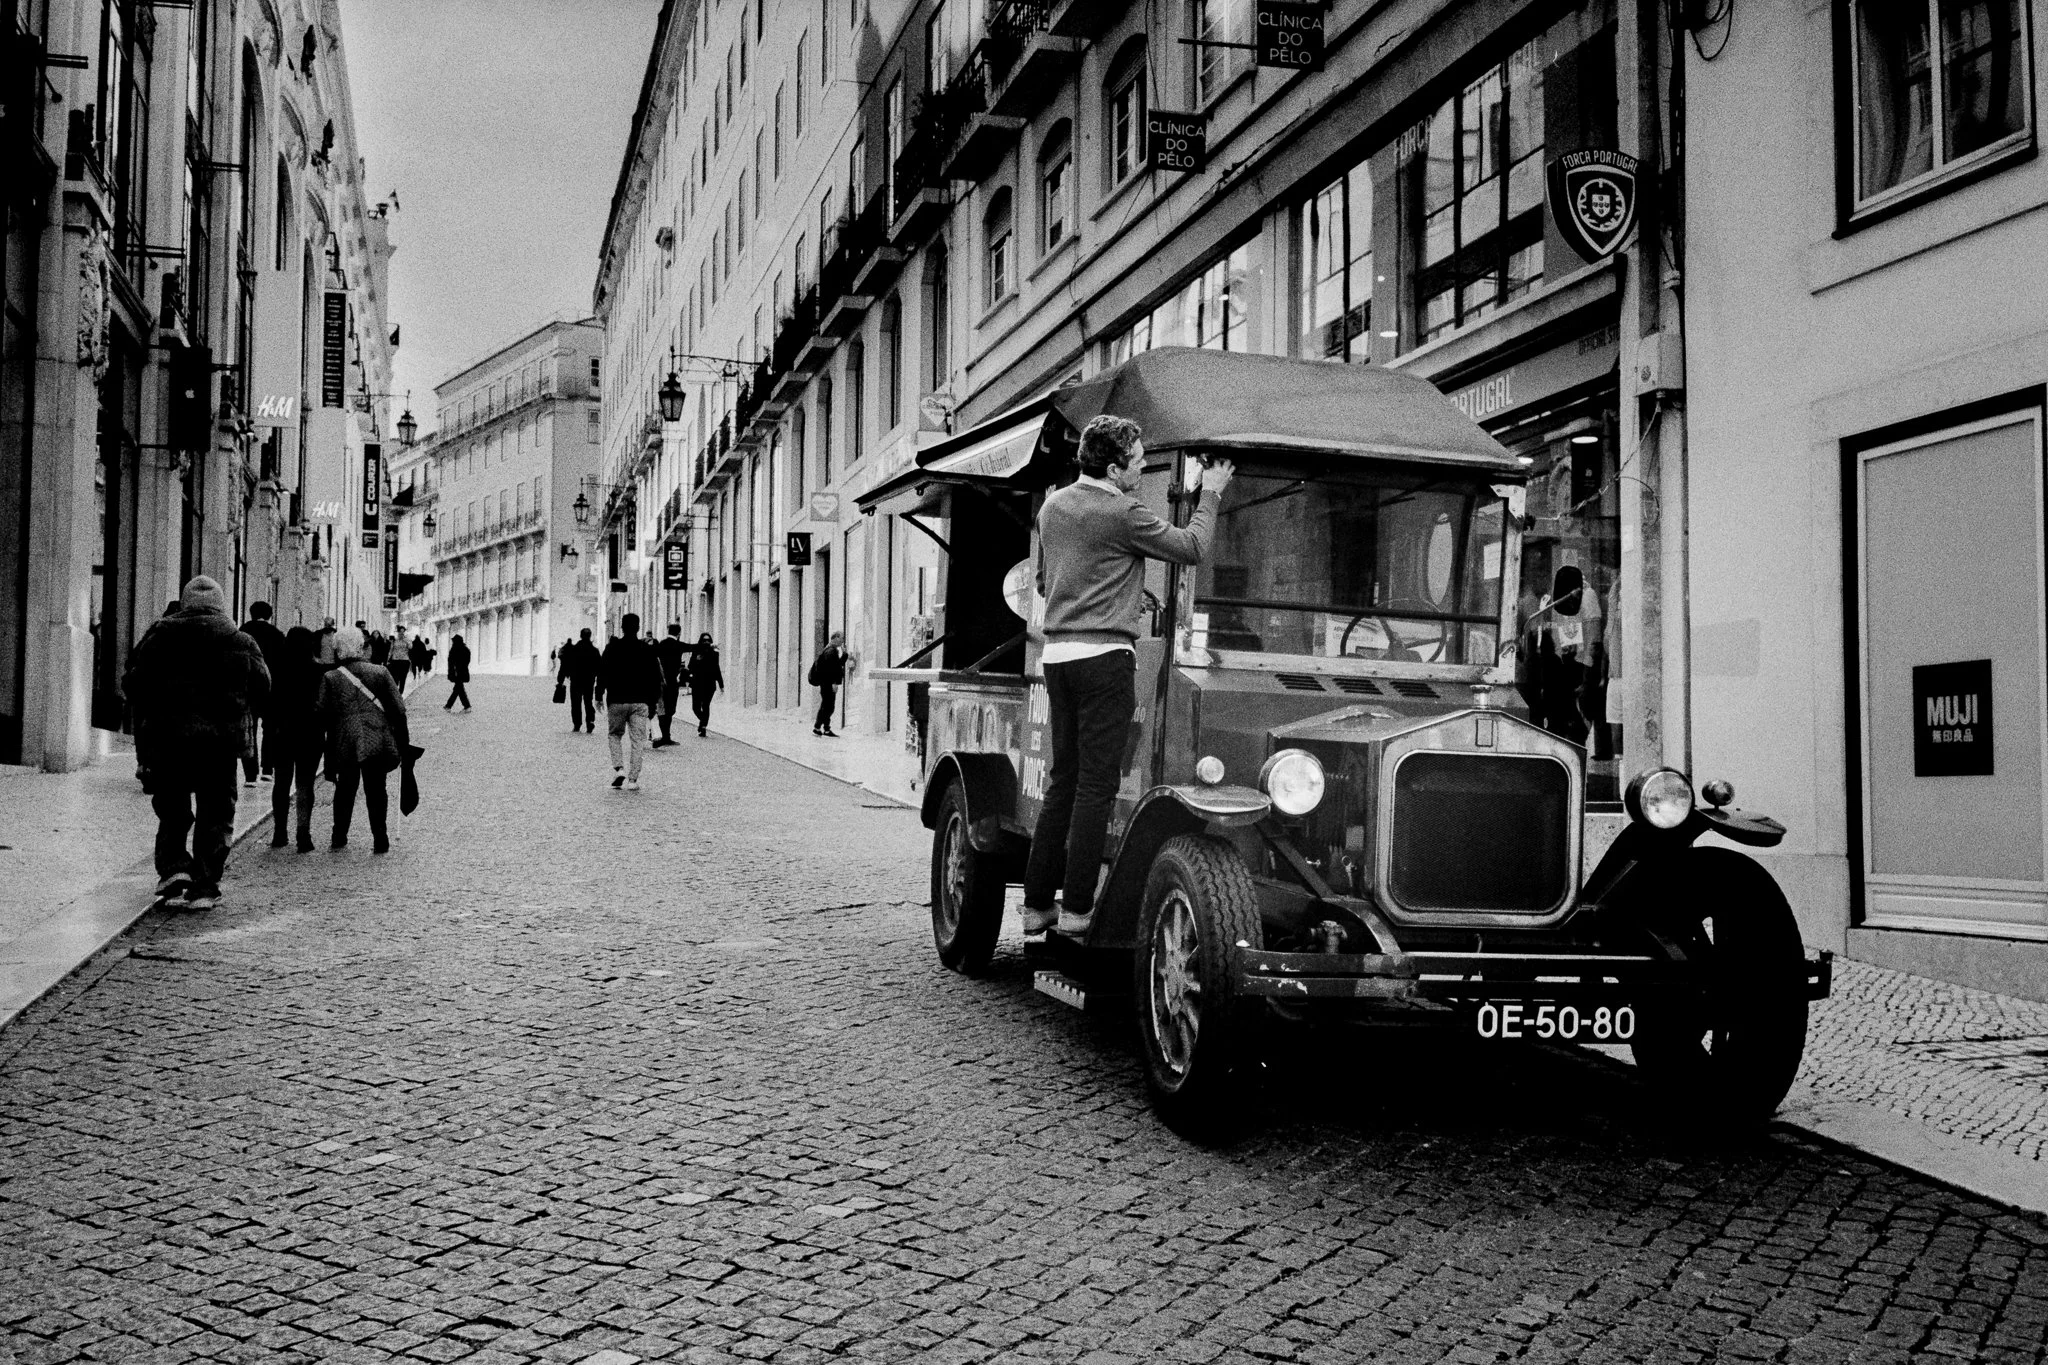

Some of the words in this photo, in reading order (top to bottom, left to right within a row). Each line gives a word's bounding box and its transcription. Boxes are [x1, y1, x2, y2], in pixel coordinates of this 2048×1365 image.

[1258, 10, 1323, 30] CLÍNICA
[1278, 31, 1303, 46] DO
[1149, 120, 1206, 138] CLÍNICA
[1165, 138, 1188, 151] DO
[1593, 150, 1638, 174] PORTUGAL
[257, 394, 294, 418] H&M
[1926, 693, 1978, 727] MUJI
